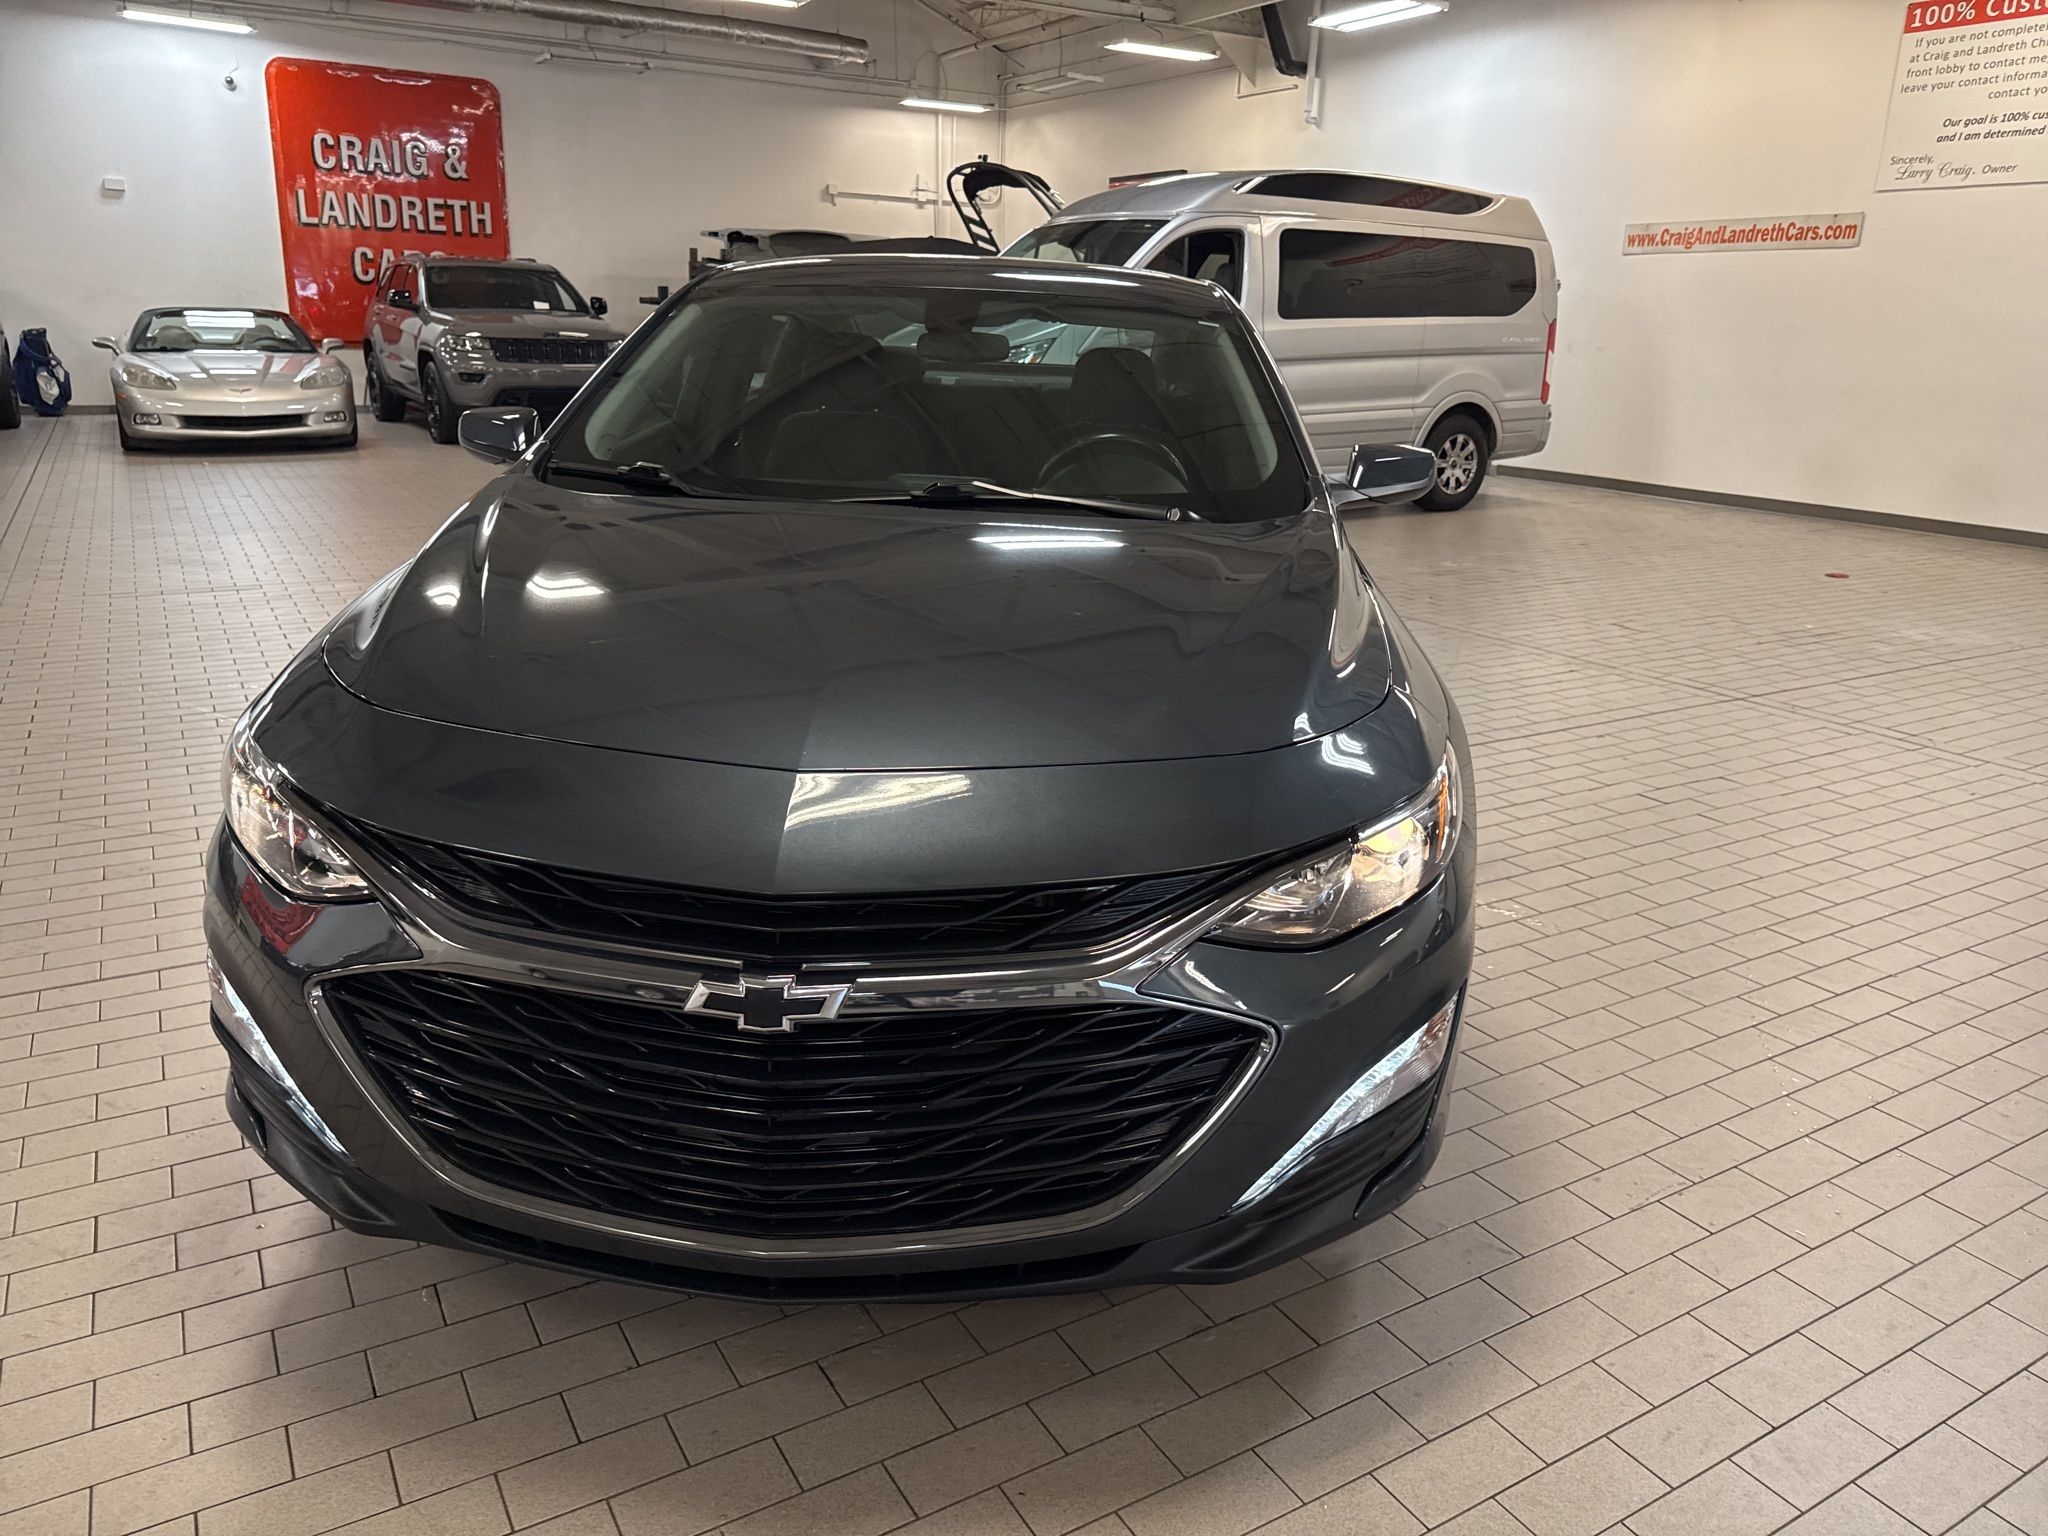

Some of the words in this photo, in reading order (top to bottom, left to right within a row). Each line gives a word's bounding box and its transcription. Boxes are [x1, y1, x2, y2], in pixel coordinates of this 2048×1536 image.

[1910, 0, 1976, 28] 100%
[1915, 37, 1925, 48] If
[1926, 37, 1945, 49] you
[1948, 34, 1966, 44] are
[1969, 30, 1989, 40] not
[1909, 54, 1920, 63] at
[1923, 51, 1950, 61] Craig
[1952, 46, 1974, 58] and
[1976, 40, 2027, 55] Landreth
[1907, 67, 1933, 78] front
[1935, 63, 1966, 75] lobby
[1968, 62, 1980, 71] to
[1983, 56, 2026, 70] contact
[1900, 83, 1928, 94] leave
[1931, 80, 1956, 92] your
[1957, 75, 2000, 88] contact
[1988, 87, 2030, 99] contact
[1942, 118, 1963, 128] Our
[1963, 114, 1988, 128] goal
[1989, 114, 1999, 124] is
[2000, 111, 2031, 123] 100%
[1936, 132, 1957, 143] and
[1958, 132, 1963, 141] I
[1964, 132, 1981, 141] am
[1983, 125, 2047, 140] determined
[311, 131, 429, 178] CRAIG
[443, 142, 469, 181] &
[1894, 165, 1933, 184] Larry
[1982, 164, 2018, 174] Owner
[296, 188, 493, 238] LANDRETH
[1627, 221, 1858, 250] www.CraigAndLandrethCars.com
